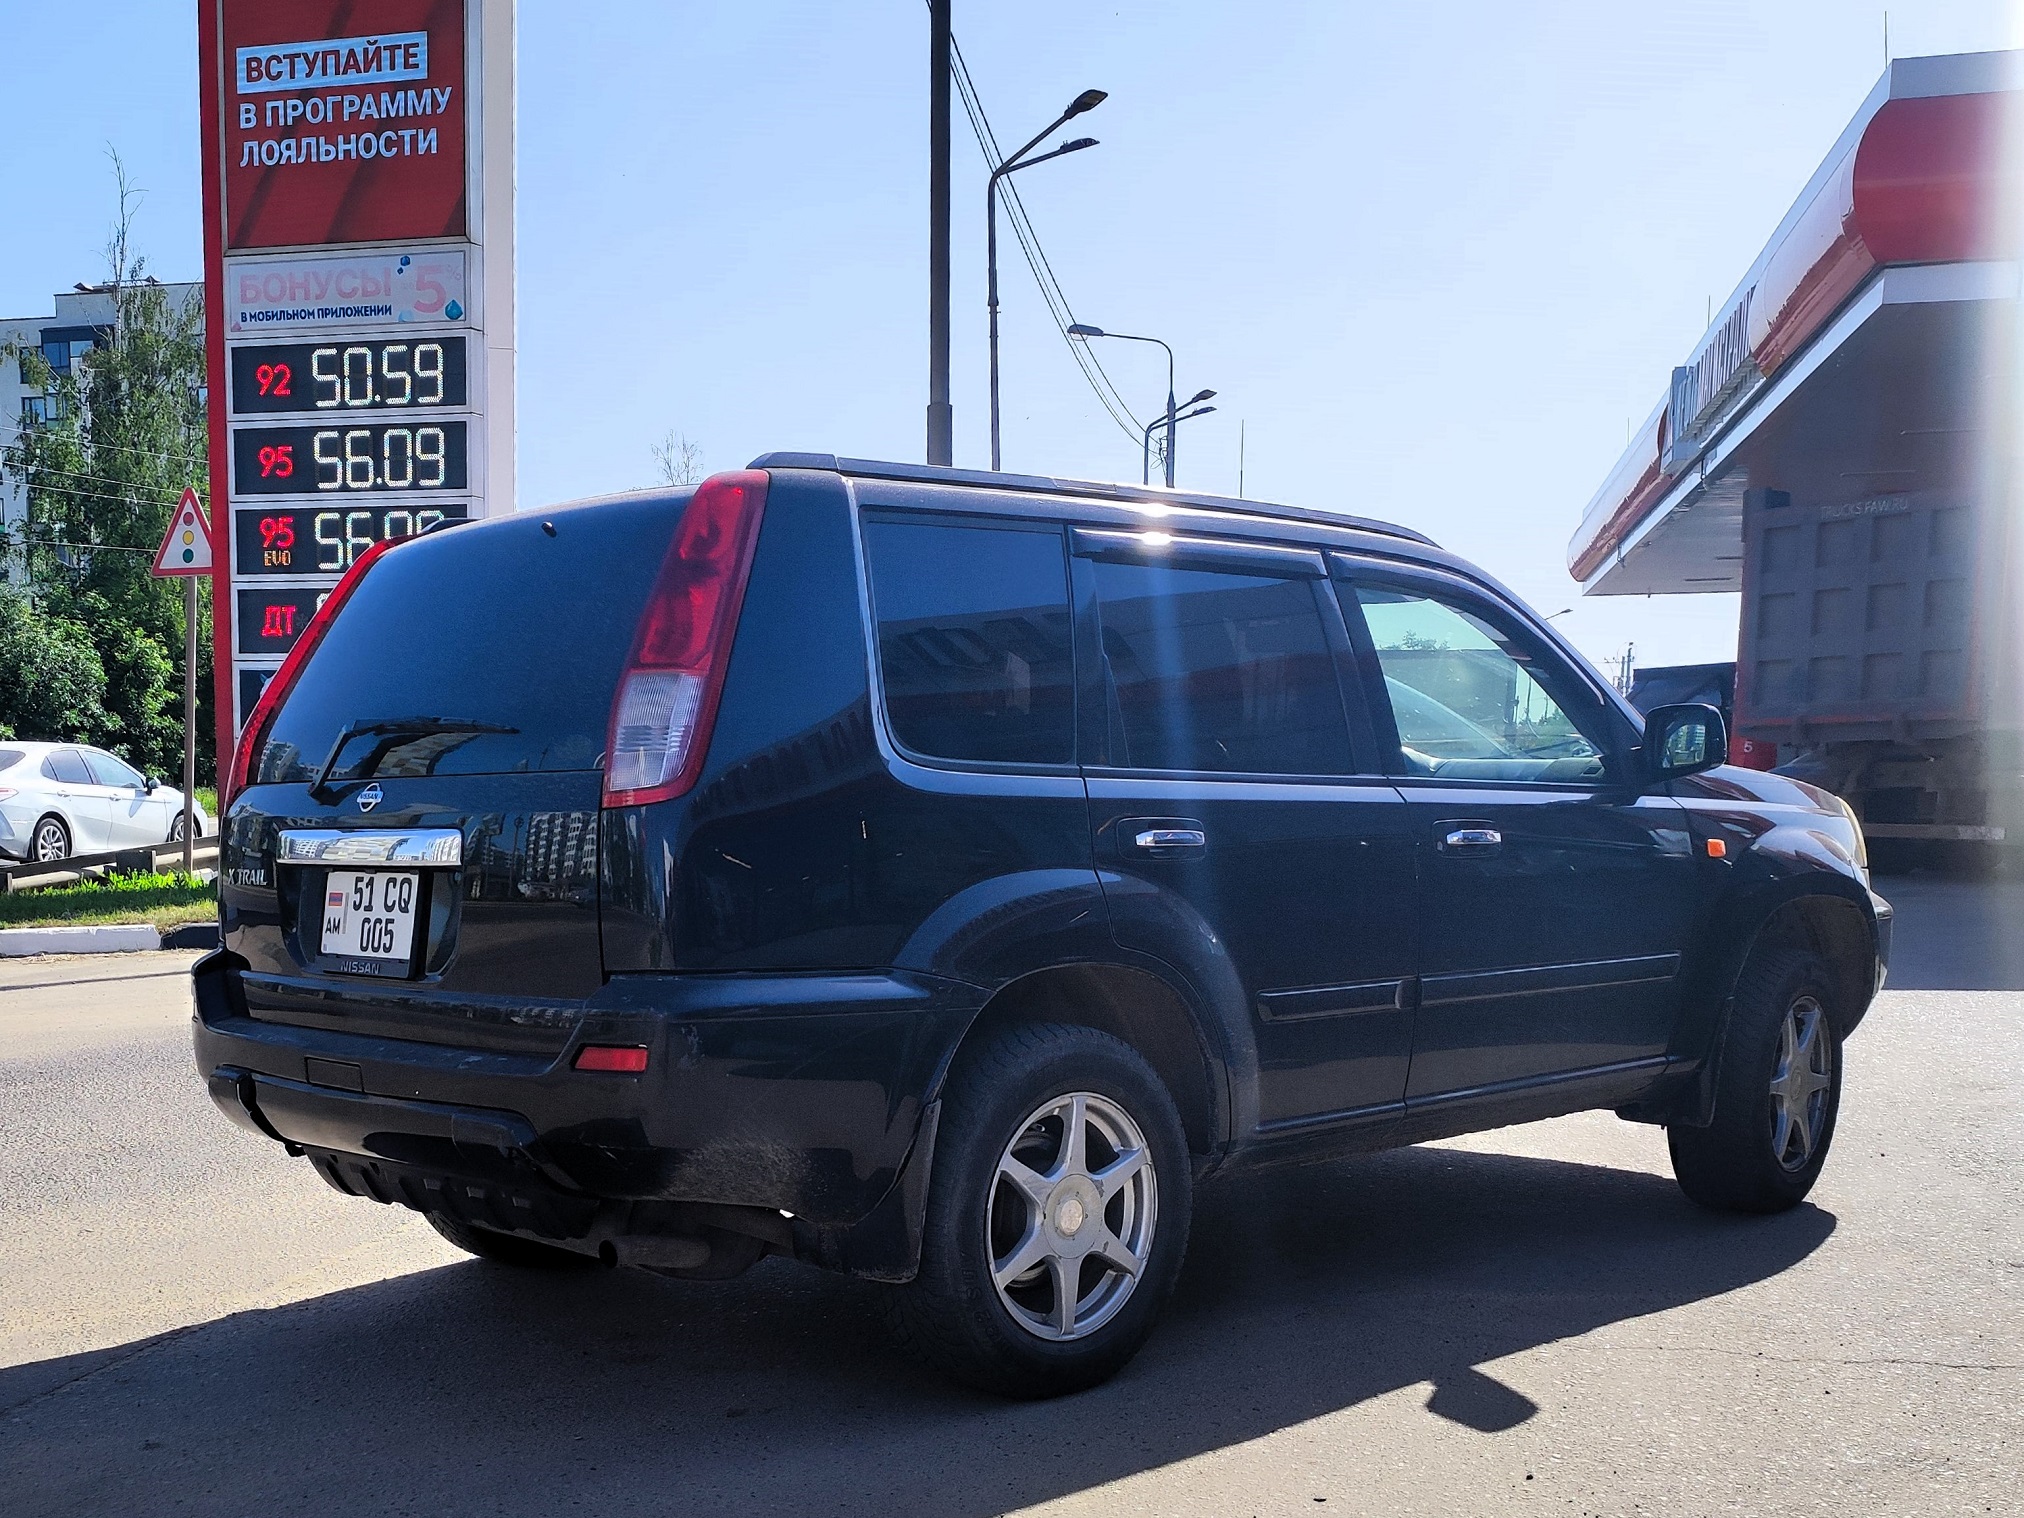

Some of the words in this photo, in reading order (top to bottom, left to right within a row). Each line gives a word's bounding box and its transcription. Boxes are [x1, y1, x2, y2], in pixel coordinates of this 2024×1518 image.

[246, 40, 420, 82] ВСТУПАЙТЕ
[240, 103, 257, 129] В
[266, 87, 452, 127] ПРОГРАММУ
[240, 128, 438, 167] ЛОЯЛЬНОСТИ
[239, 267, 392, 304] БОНУСЫ
[240, 312, 248, 323] В
[250, 308, 315, 323] МОБИЛЬНОМ
[317, 305, 392, 320] ПРИЛОЖЕНИИ
[256, 364, 291, 396] 92
[312, 343, 443, 407] 50.59
[258, 446, 293, 478] 95
[314, 427, 445, 489] 56.09
[259, 517, 295, 549] 95
[264, 550, 291, 567] EVO
[262, 605, 297, 637] ДТ
[1743, 740, 1753, 753] 5
[228, 868, 235, 885] X
[236, 868, 267, 886] TRAIL
[353, 876, 375, 912] 51
[384, 877, 412, 914] CQ
[325, 916, 341, 935] AM
[359, 917, 395, 954] 005
[340, 960, 380, 975] NISSAN
